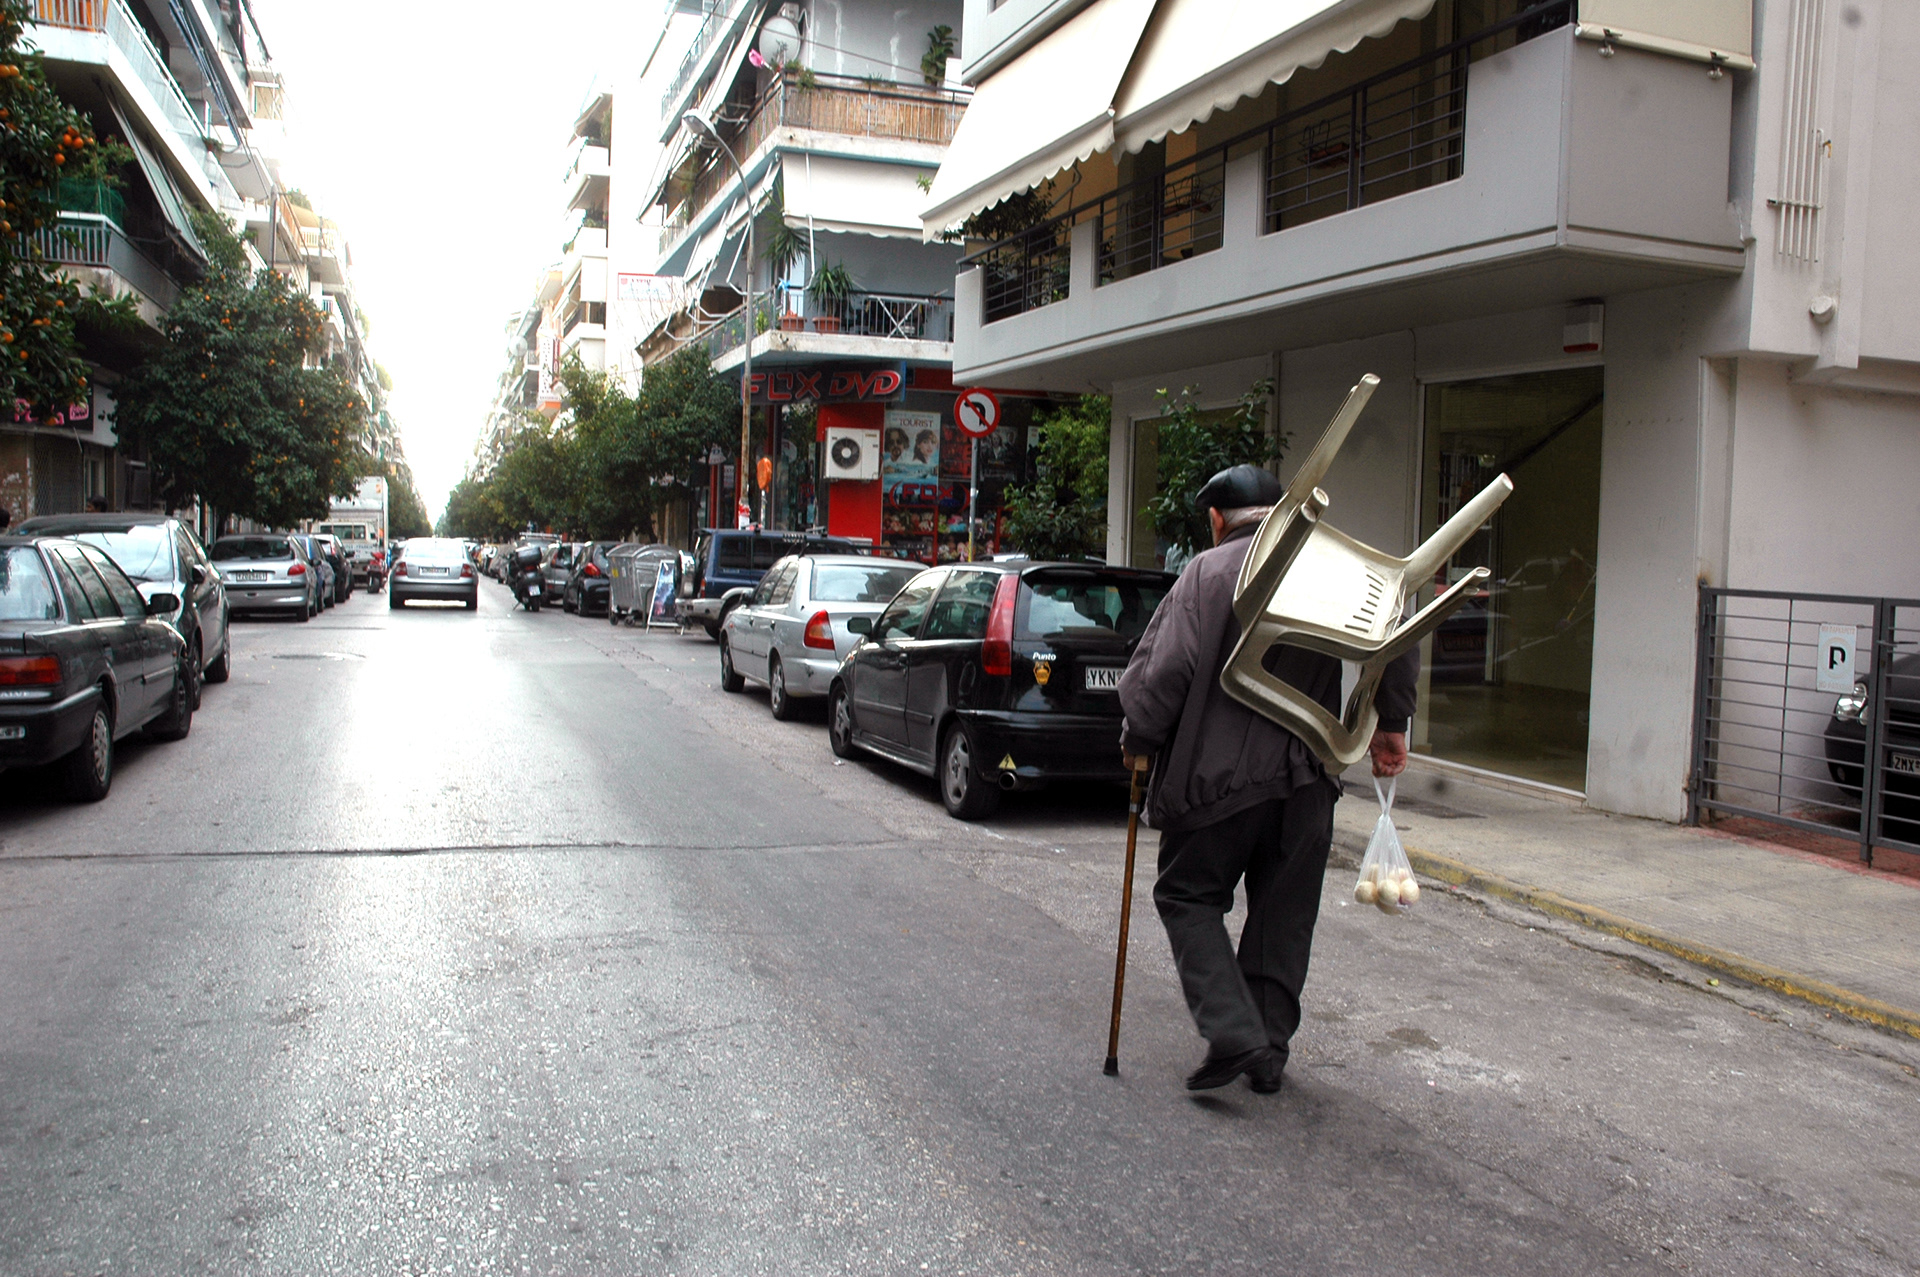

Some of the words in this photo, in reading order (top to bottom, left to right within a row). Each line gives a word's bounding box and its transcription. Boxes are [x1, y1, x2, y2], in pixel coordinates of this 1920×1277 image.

[829, 369, 901, 399] DVD
[900, 418, 934, 428] TOURIST
[902, 483, 954, 500] FOX
[1032, 651, 1057, 661] Punto
[1089, 669, 1121, 687] YKN
